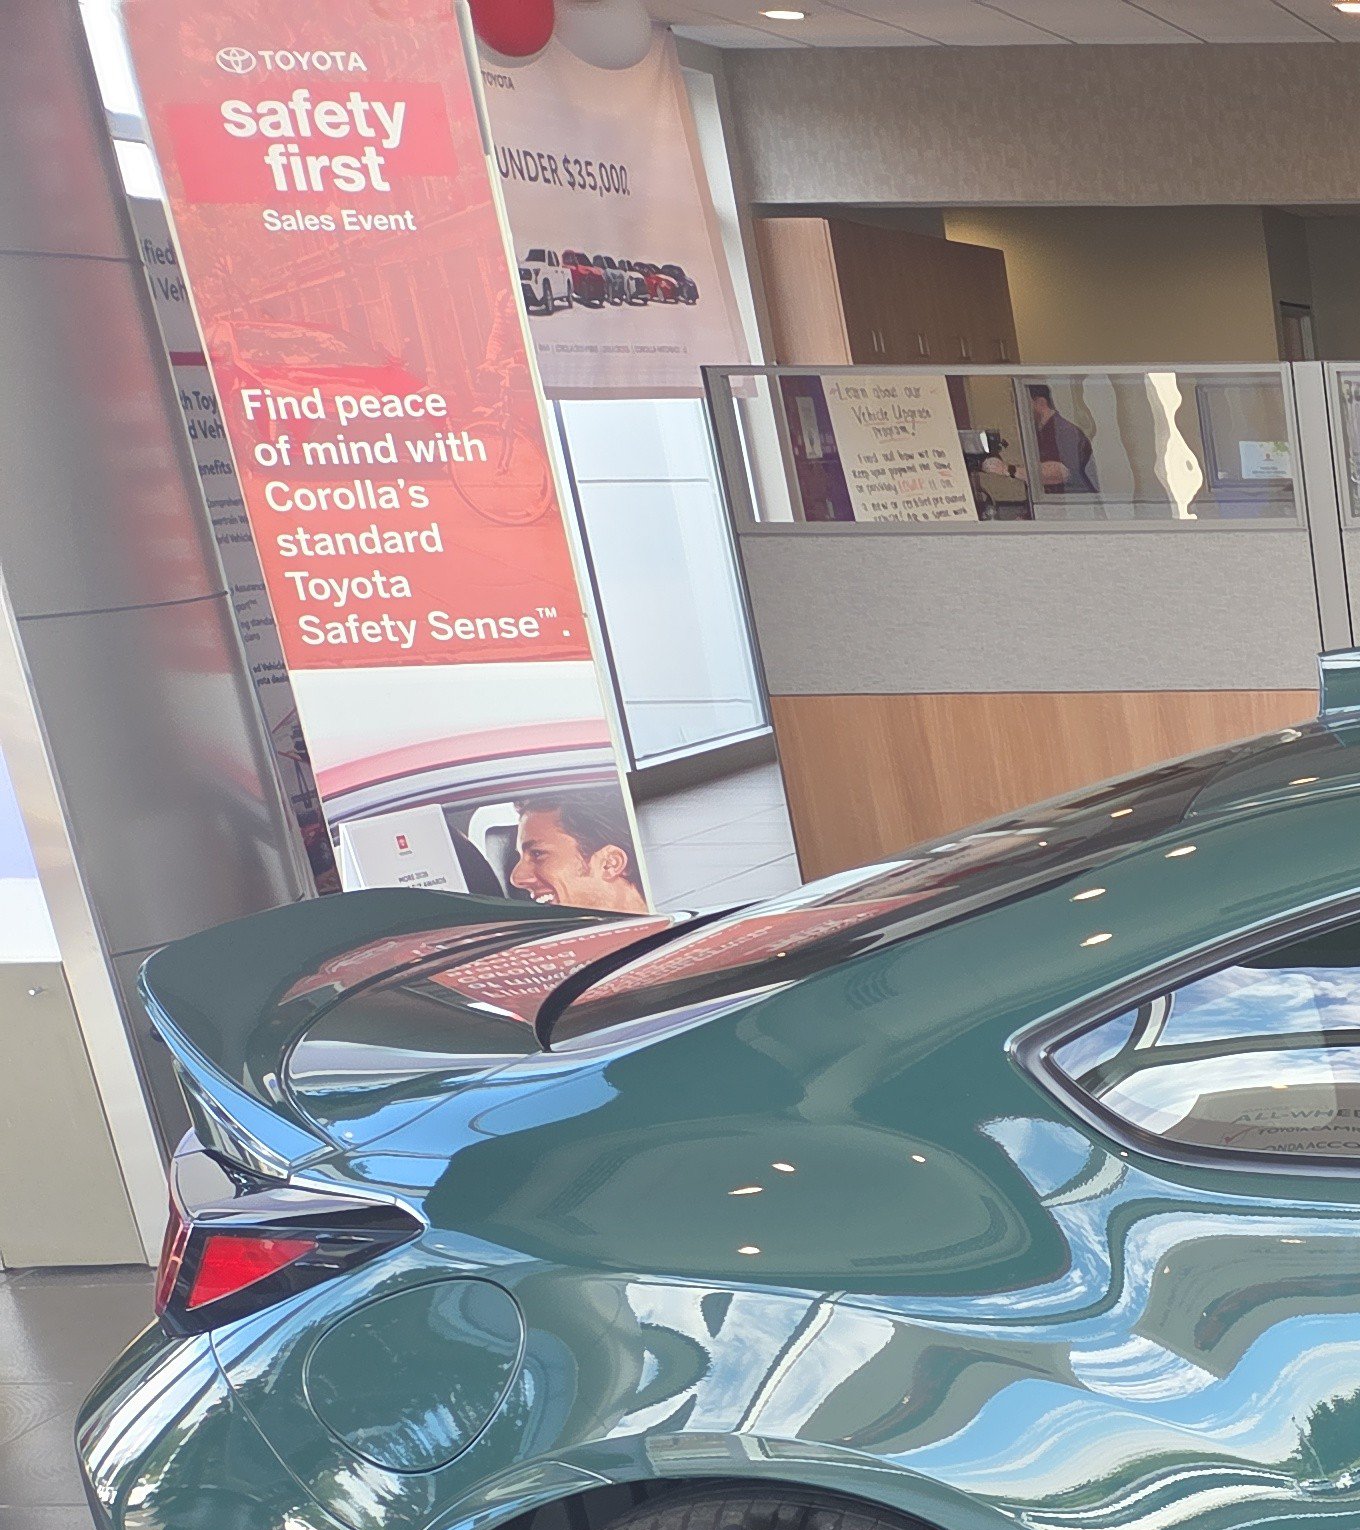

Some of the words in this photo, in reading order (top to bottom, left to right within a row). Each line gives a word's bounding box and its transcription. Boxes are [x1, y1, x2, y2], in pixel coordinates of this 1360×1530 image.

[258, 50, 367, 72] TOYOTA
[220, 89, 407, 147] safety
[264, 144, 391, 194] first
[495, 145, 563, 186] UNDER
[262, 209, 336, 233] Sales
[343, 207, 416, 232] Event
[242, 388, 326, 422] Find
[336, 393, 447, 426] peace
[254, 435, 294, 467] of
[303, 434, 397, 465] mind
[405, 431, 487, 463] with
[278, 522, 443, 558] standard
[286, 571, 411, 608] Toyota
[301, 615, 418, 650] Safety
